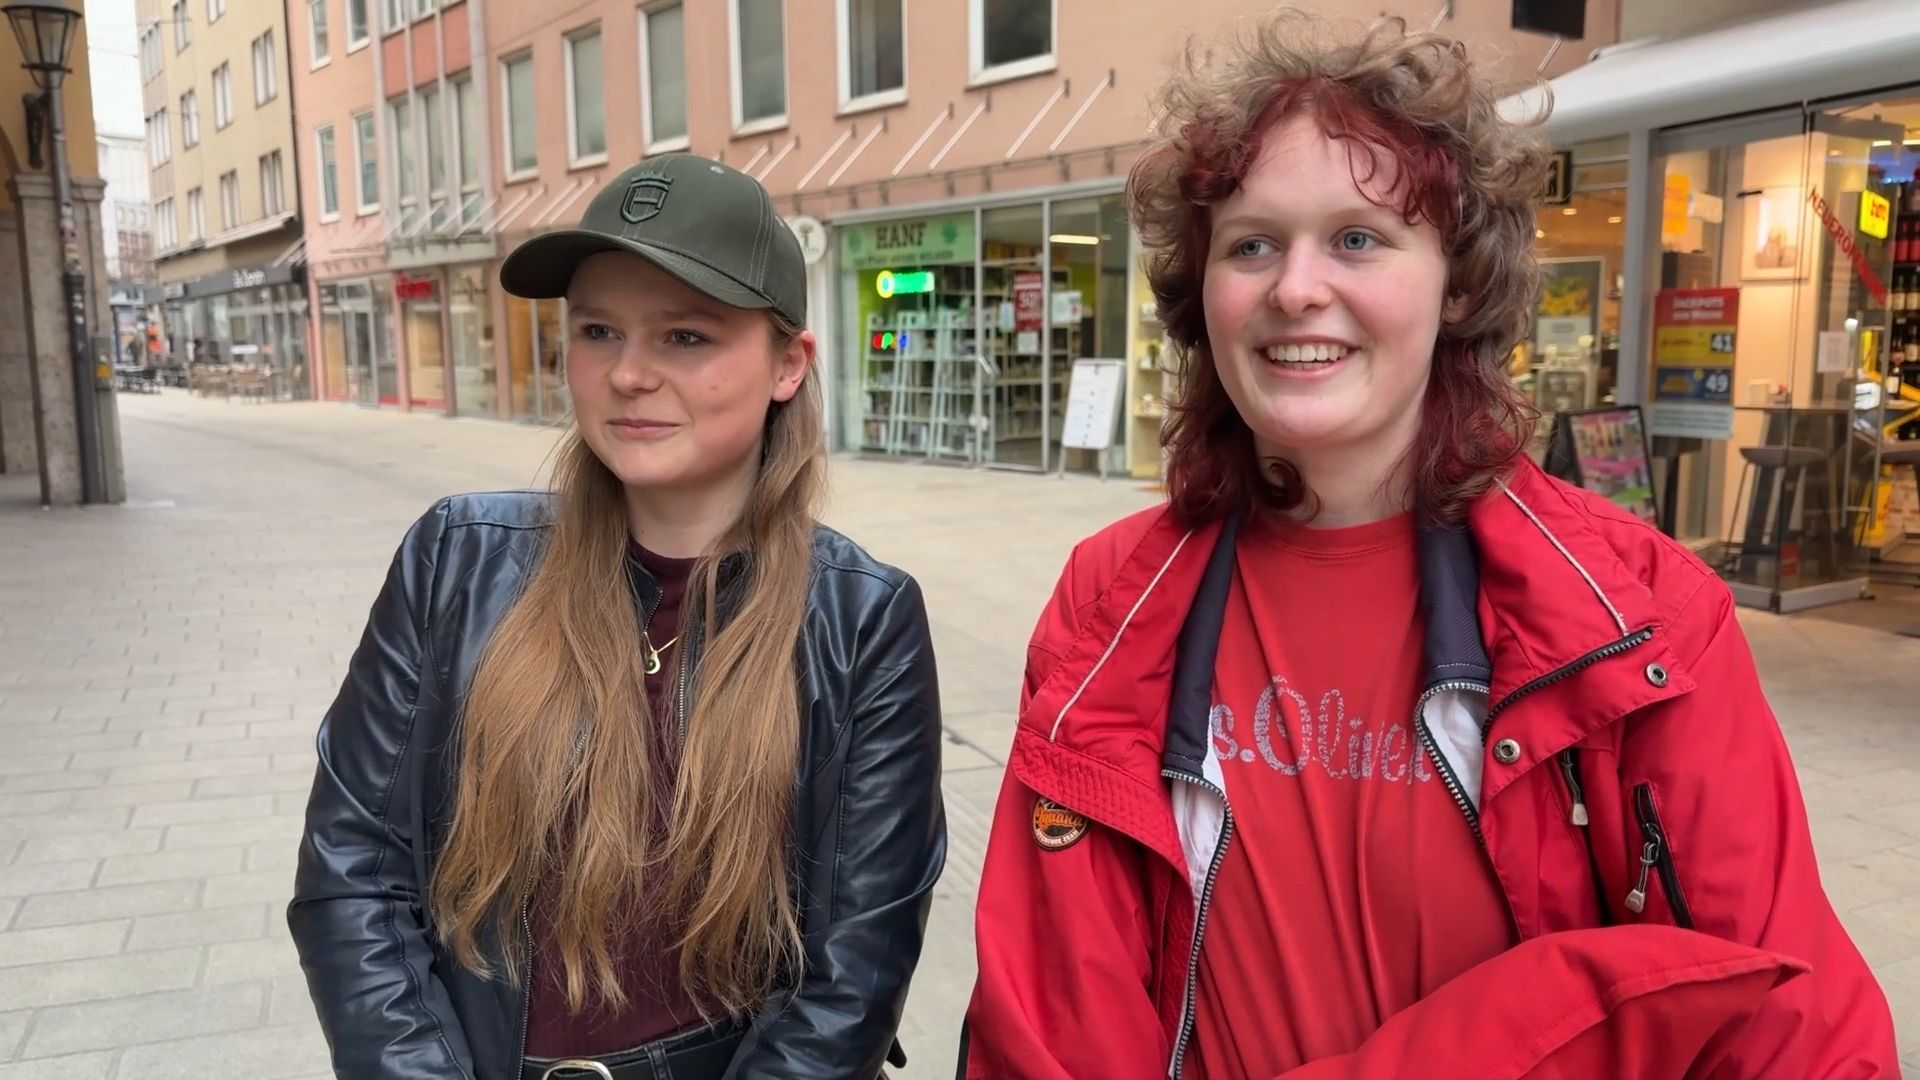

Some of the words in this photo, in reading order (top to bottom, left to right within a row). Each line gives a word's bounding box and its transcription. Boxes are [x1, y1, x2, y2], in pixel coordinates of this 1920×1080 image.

[876, 222, 927, 250] HANF
[1711, 333, 1733, 353] 41
[1705, 373, 1729, 393] 49
